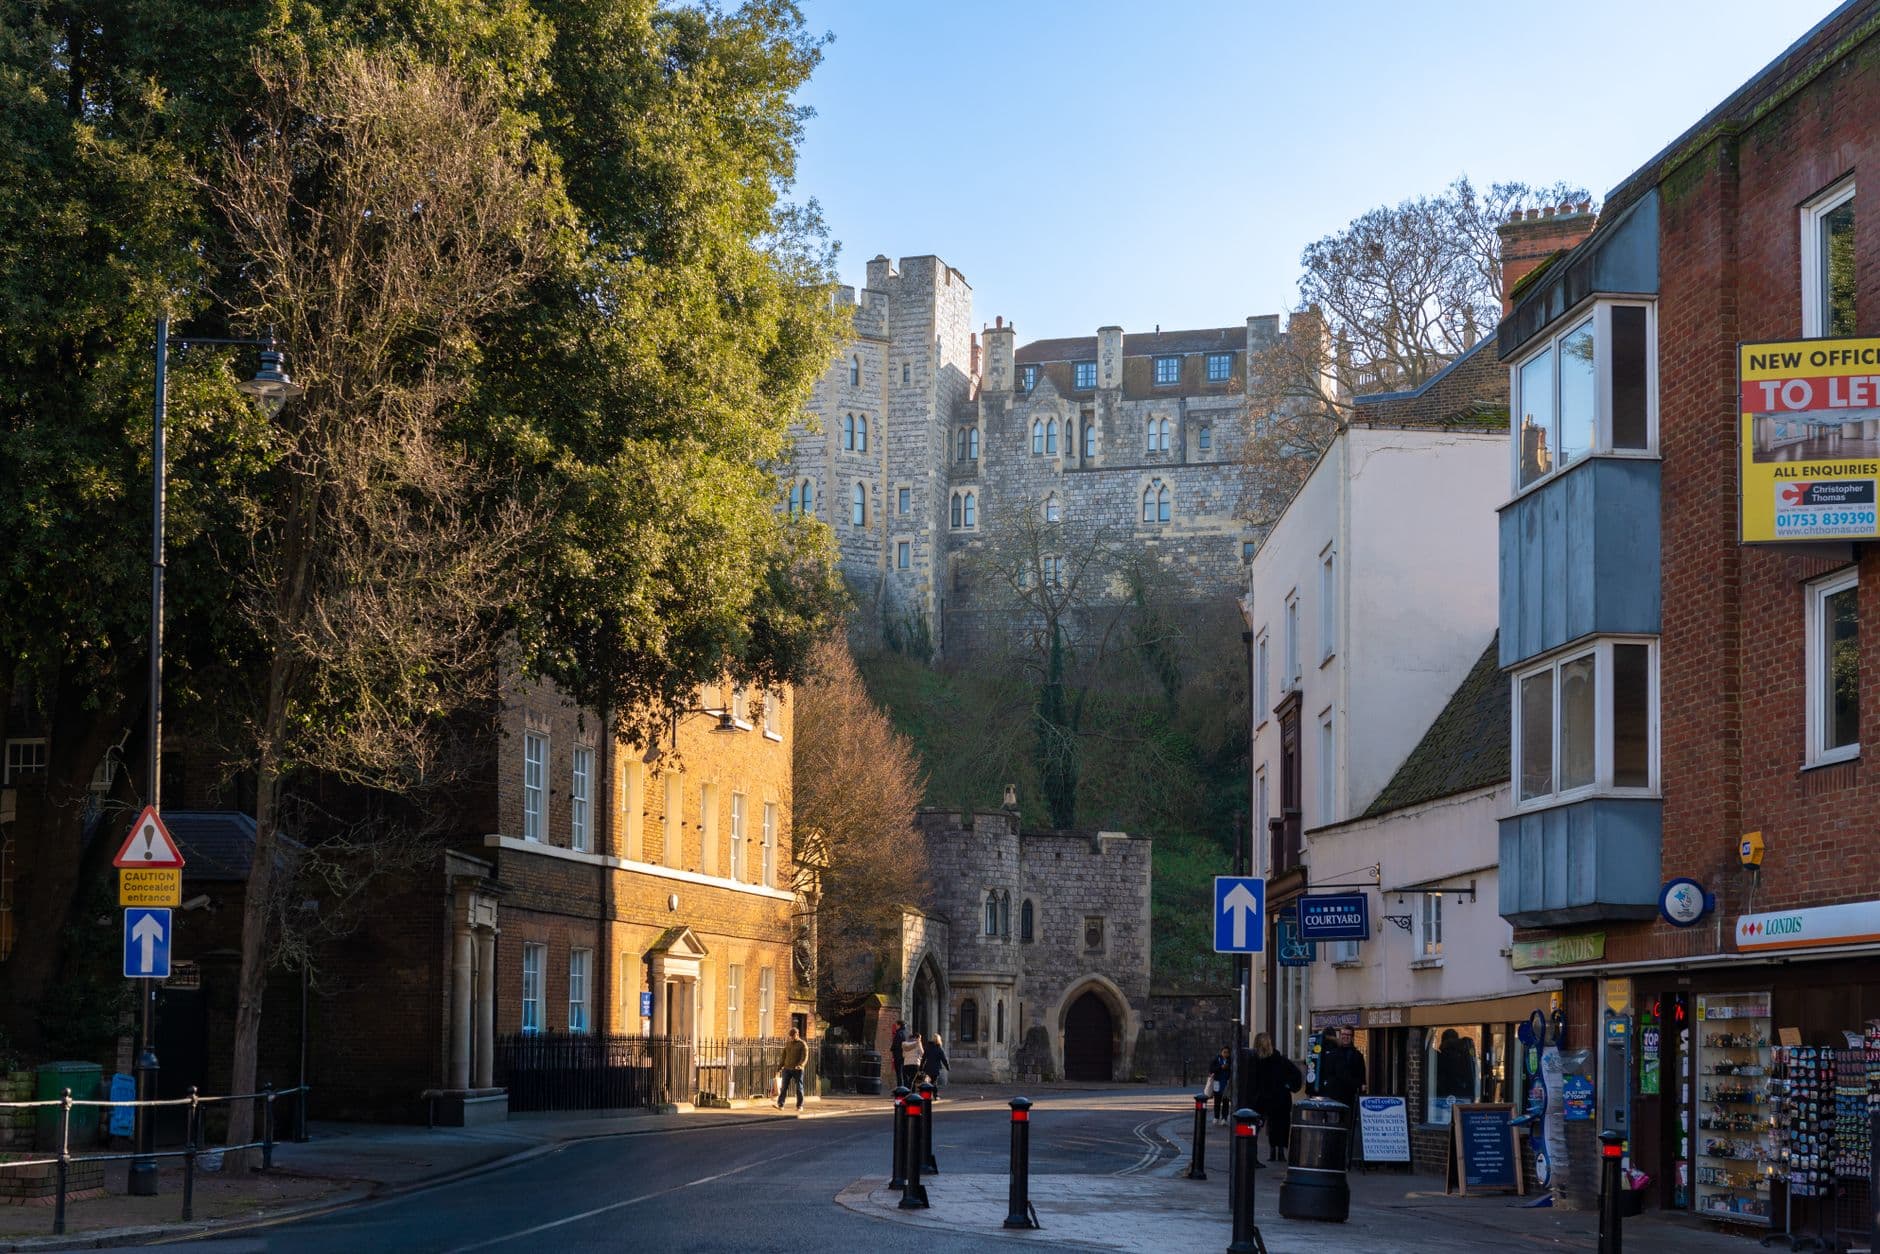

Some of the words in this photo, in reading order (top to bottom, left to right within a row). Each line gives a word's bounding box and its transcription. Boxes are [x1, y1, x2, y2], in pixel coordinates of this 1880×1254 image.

[1749, 352, 1802, 370] NEW
[1810, 349, 1880, 367] OFFIC
[1759, 379, 1813, 410] TO
[1774, 466, 1798, 477] ALL
[1802, 463, 1878, 477] ENQUIRIES
[1812, 484, 1864, 494] Christopher
[1811, 494, 1846, 502] Thomas
[1777, 512, 1818, 527] 01753
[1822, 511, 1875, 526] 839390
[1777, 525, 1875, 536] www.chthomas.com
[125, 872, 174, 881] CAUTION
[124, 882, 176, 891] Concealed
[127, 893, 172, 902] entrance
[1305, 914, 1361, 926] COURTYARD
[1765, 916, 1803, 935] LONDIS
